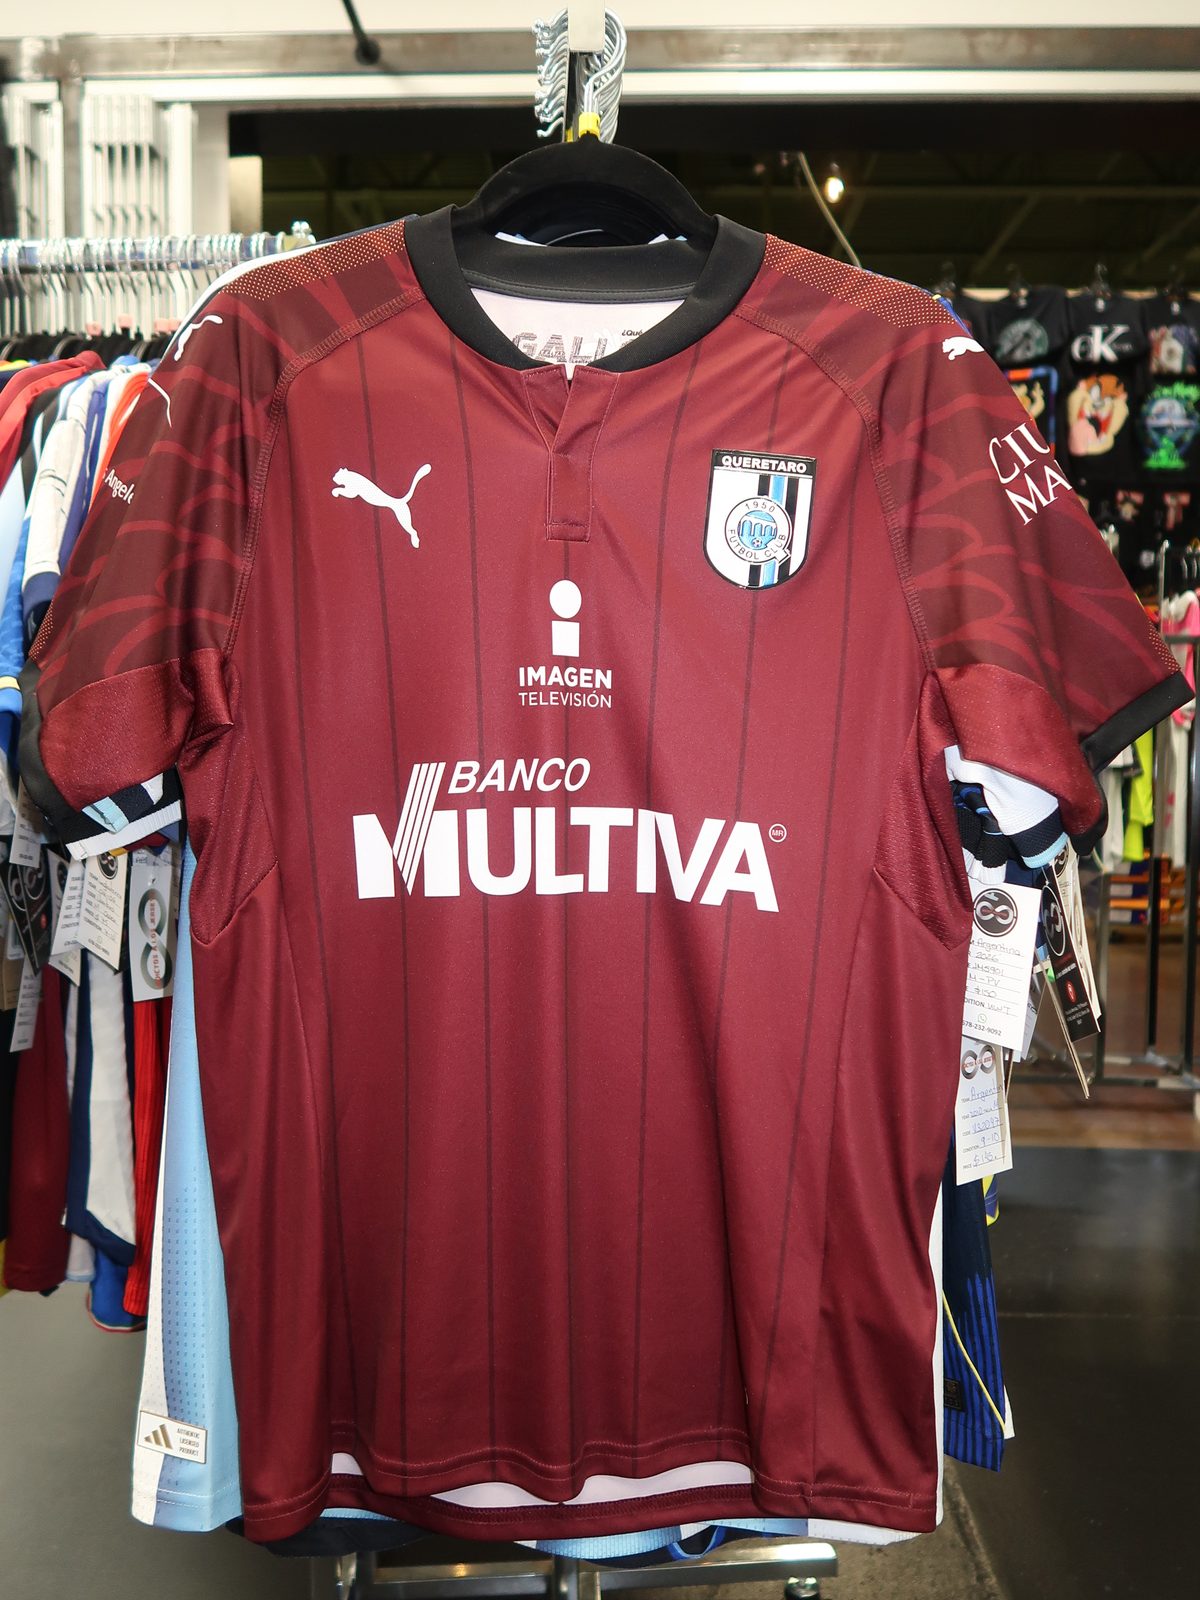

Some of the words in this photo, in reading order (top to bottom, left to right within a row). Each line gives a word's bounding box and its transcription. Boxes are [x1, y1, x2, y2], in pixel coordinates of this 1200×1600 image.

[721, 455, 807, 474] QUERETARO
[744, 500, 776, 513] 1950
[728, 529, 760, 560] FUTBOL
[764, 534, 787, 558] CLUB
[518, 666, 612, 690] IMAGEN
[518, 689, 612, 709] TELEVISIÓN
[447, 757, 591, 794] BANCO
[352, 762, 780, 913] MULTIVA
[964, 998, 985, 1008] DITION
